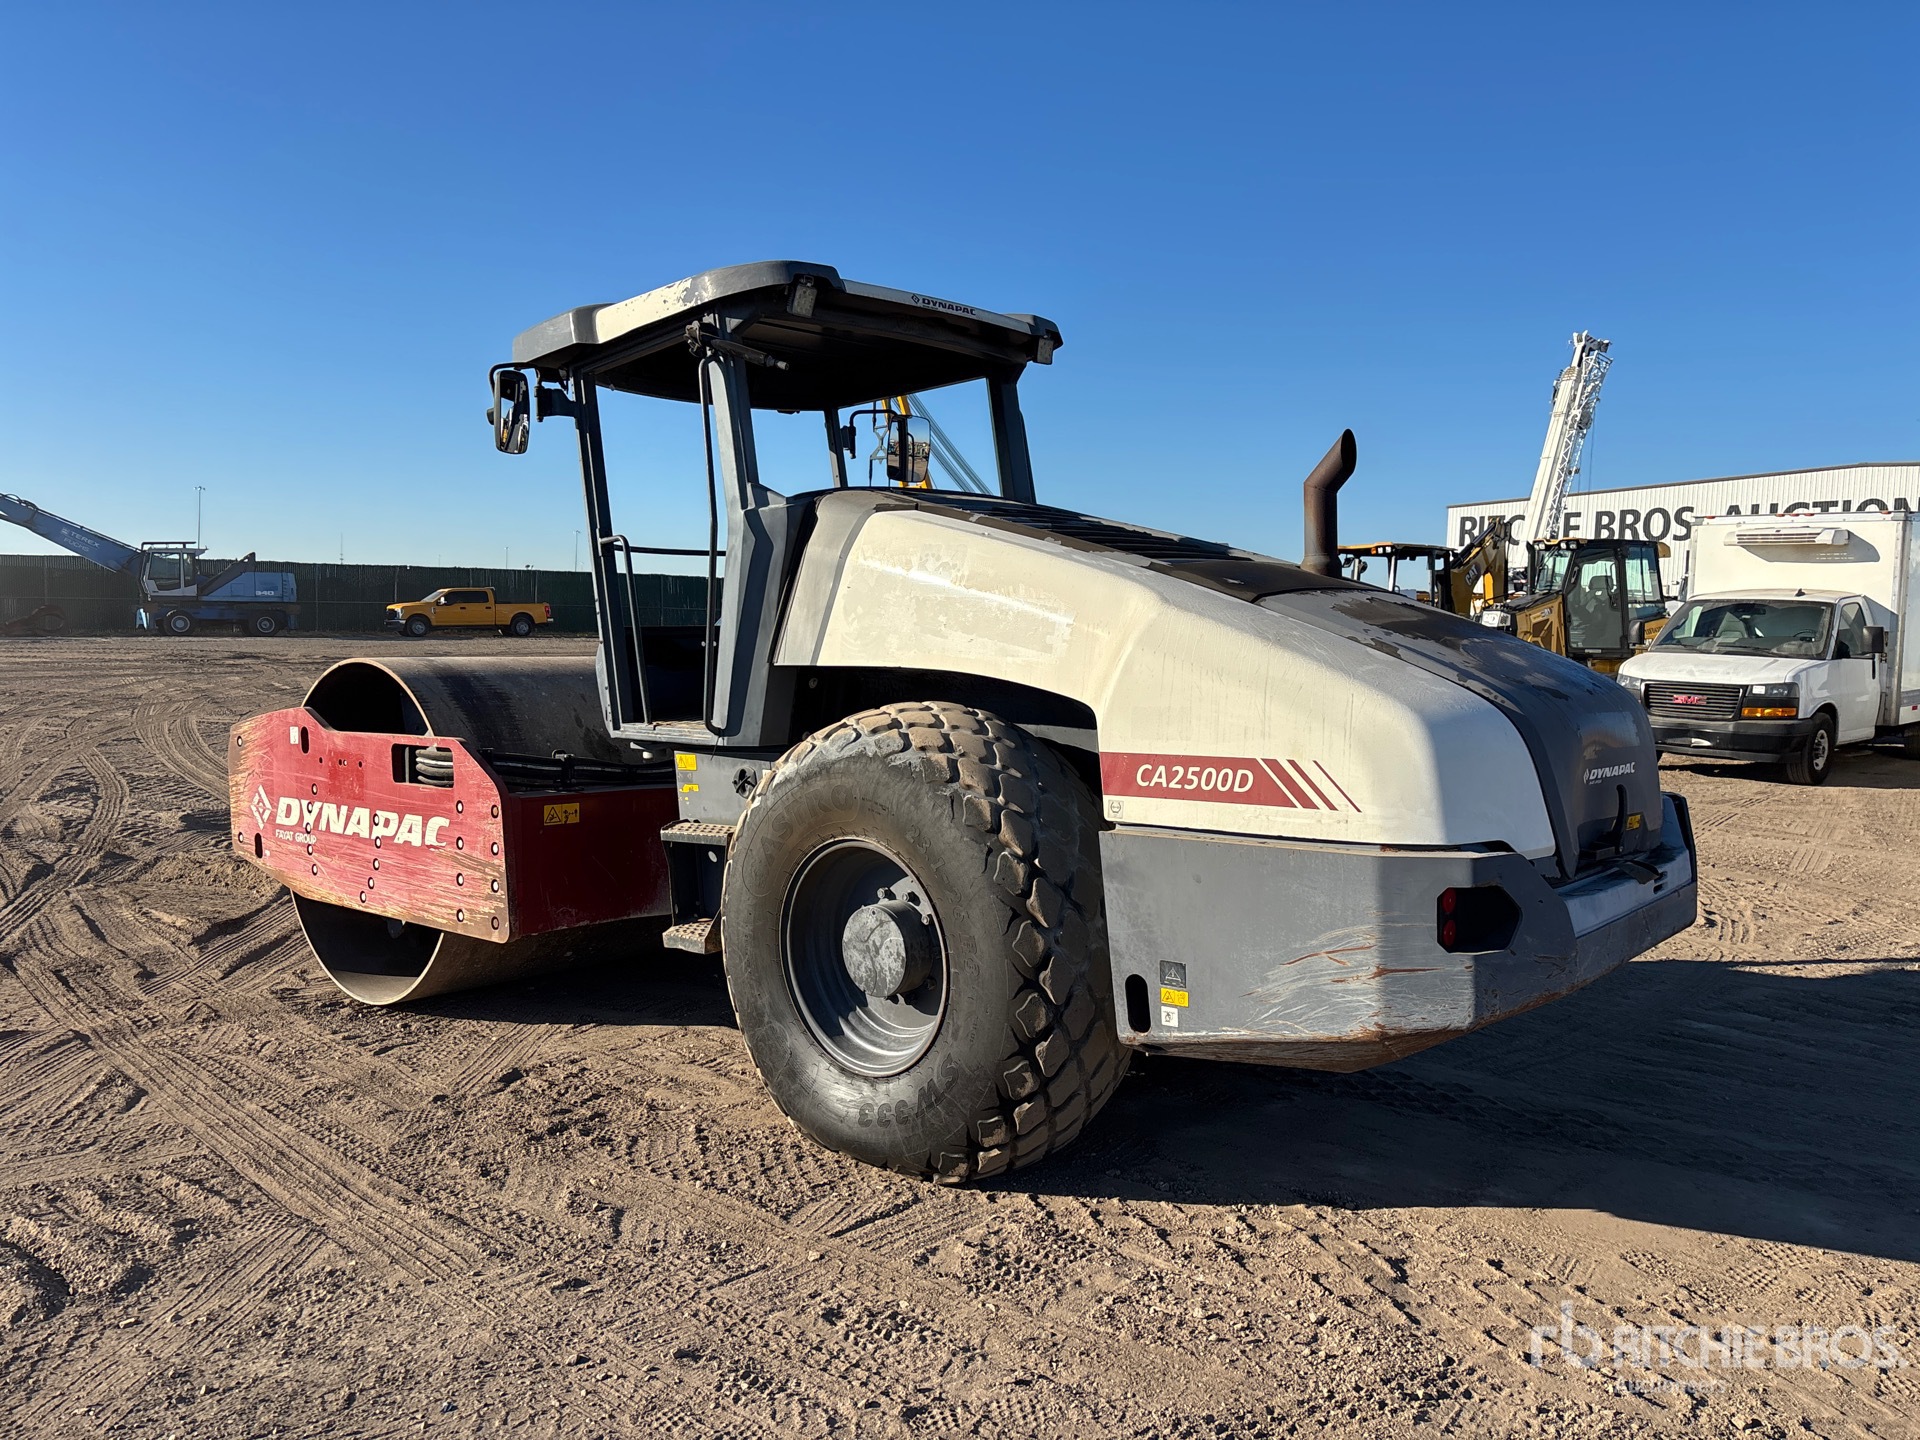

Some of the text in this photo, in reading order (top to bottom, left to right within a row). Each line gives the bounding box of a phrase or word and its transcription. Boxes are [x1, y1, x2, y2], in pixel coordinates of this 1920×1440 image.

[922, 297, 976, 316] DYNAPAC
[63, 537, 90, 552] FUCHS
[70, 531, 100, 548] TEREX
[1465, 564, 1479, 586] CAT
[1672, 694, 1708, 705] GMC
[1136, 764, 1254, 793] CA2500D
[1588, 761, 1636, 780] DYNAPAC
[275, 796, 451, 847] DYNAPAC
[275, 829, 317, 844] FAYAT GROUP
